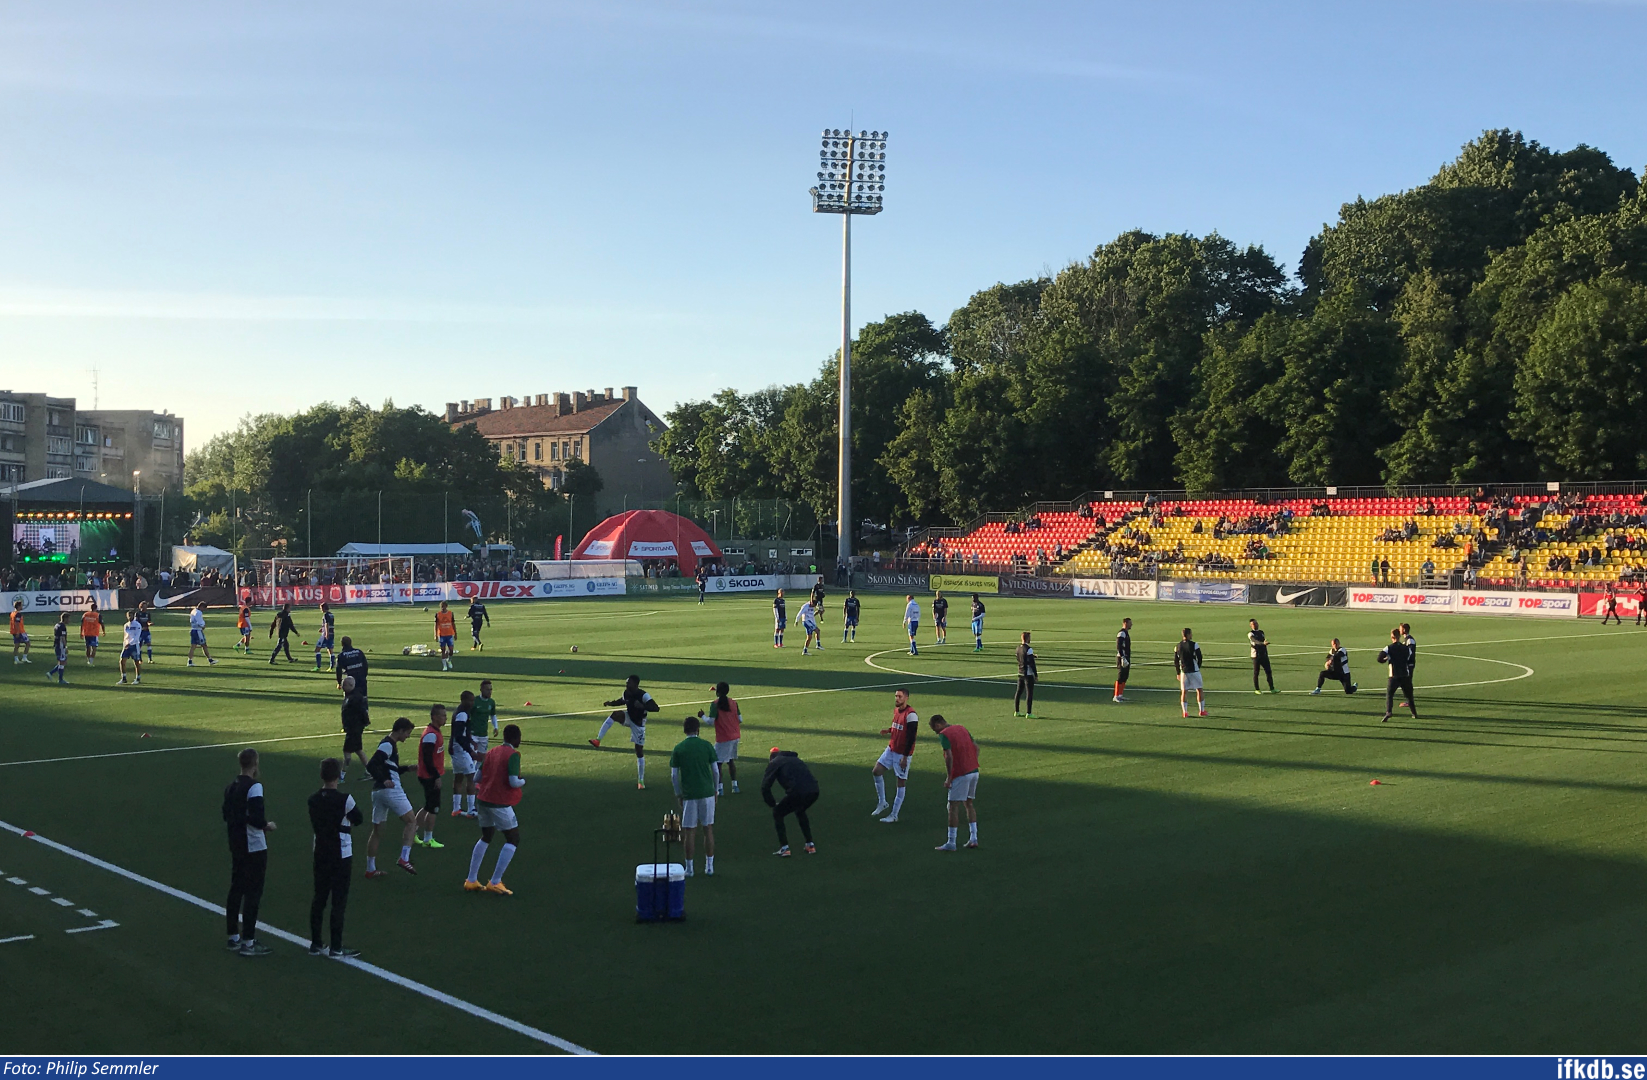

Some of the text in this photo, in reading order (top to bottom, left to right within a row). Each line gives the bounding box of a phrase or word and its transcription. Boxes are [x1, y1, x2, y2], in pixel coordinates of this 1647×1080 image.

[729, 578, 765, 588] ŠKODA
[1008, 580, 1047, 591] VILNIAUS
[1078, 581, 1151, 597] HANNER
[35, 594, 97, 606] ŠKODA
